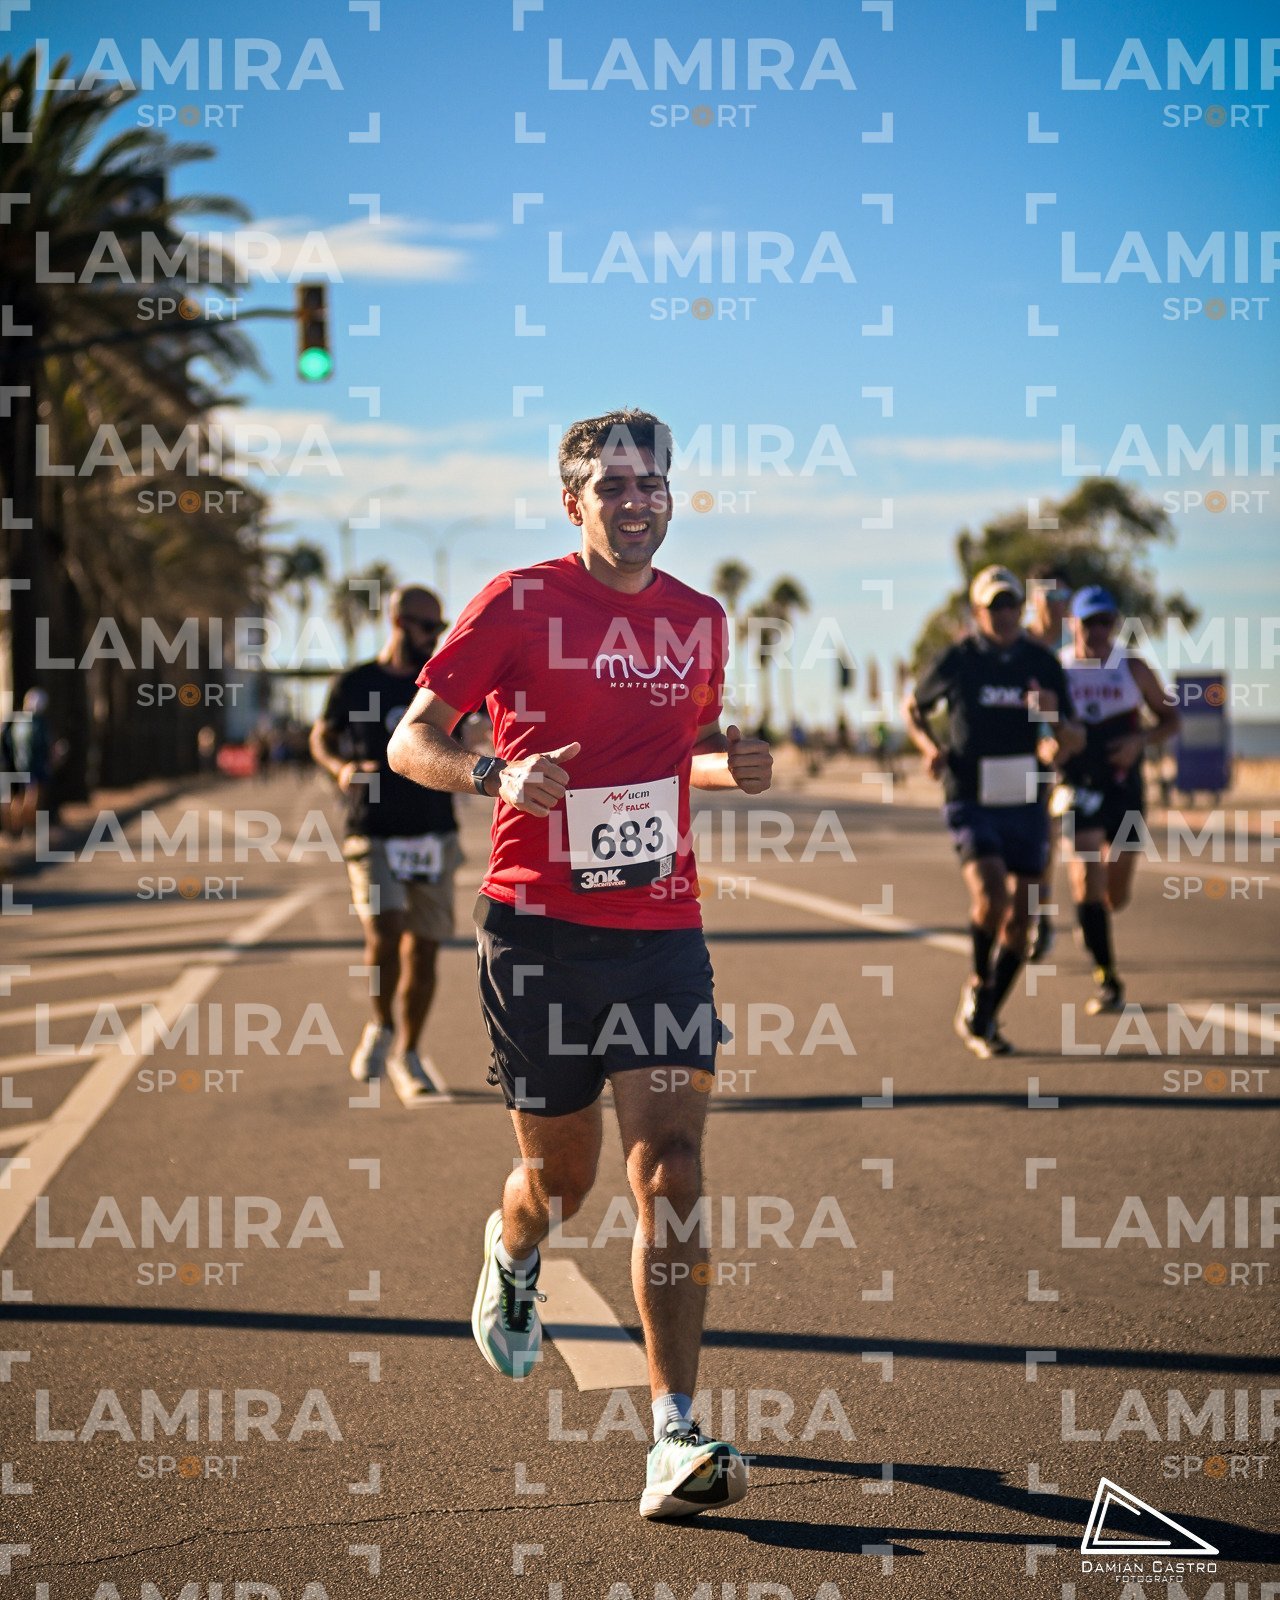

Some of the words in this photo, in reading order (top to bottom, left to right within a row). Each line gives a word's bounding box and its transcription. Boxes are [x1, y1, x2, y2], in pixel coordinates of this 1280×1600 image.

[628, 790, 650, 800] ucm
[625, 802, 651, 812] FALCK
[591, 816, 664, 860] 683
[580, 868, 622, 889] 30K
